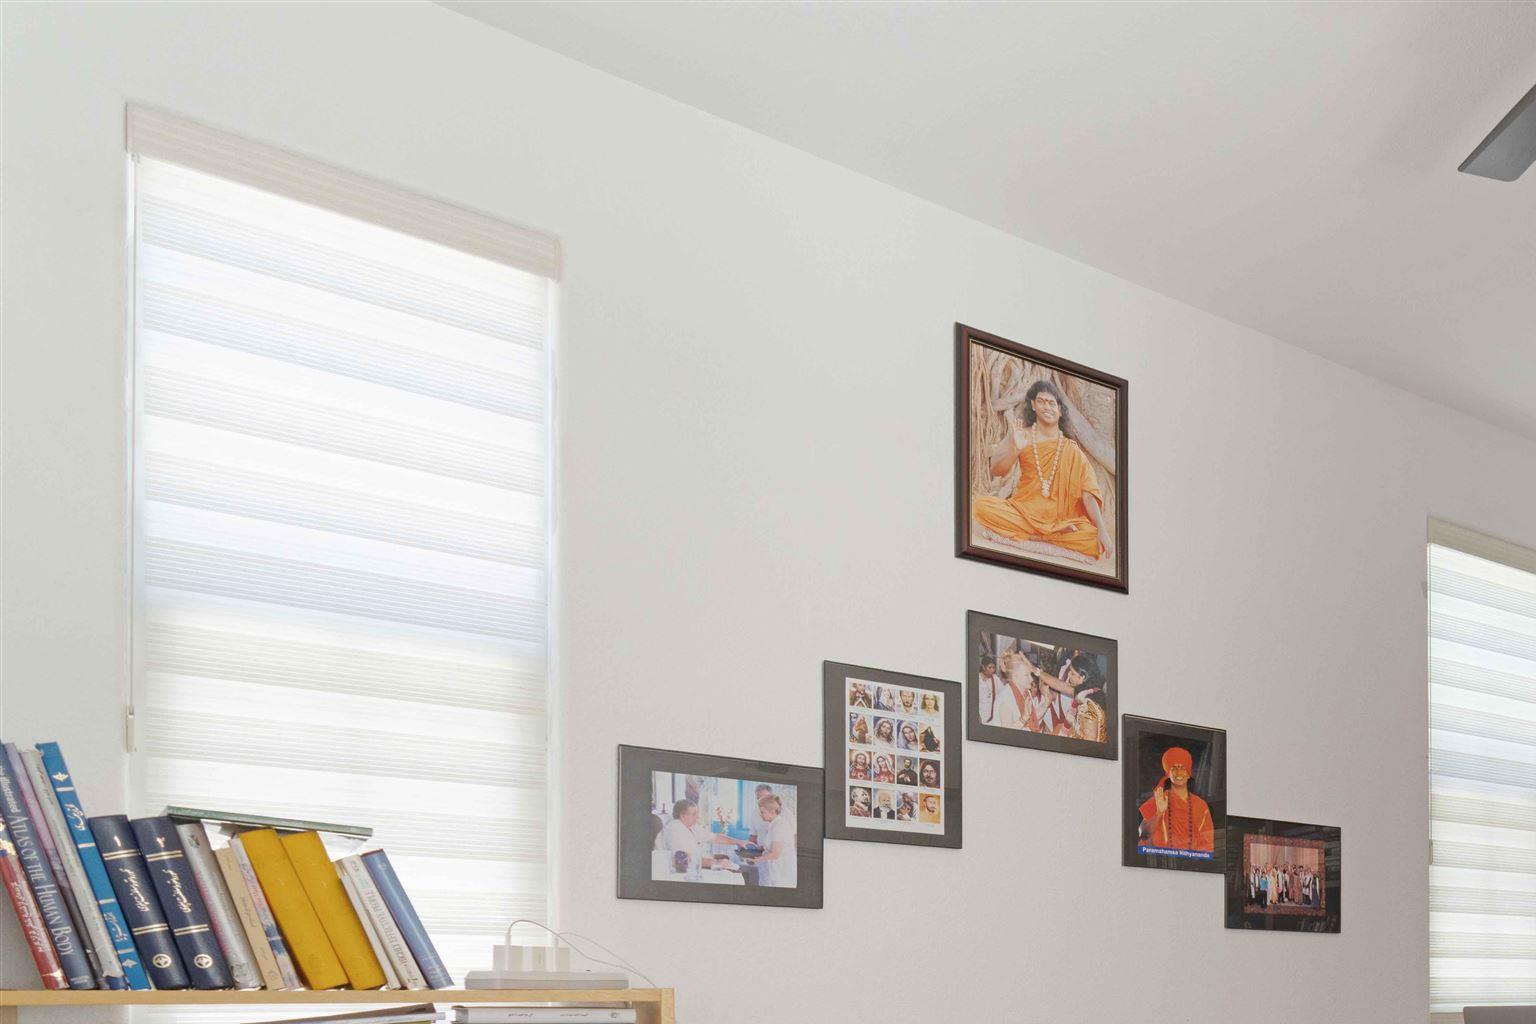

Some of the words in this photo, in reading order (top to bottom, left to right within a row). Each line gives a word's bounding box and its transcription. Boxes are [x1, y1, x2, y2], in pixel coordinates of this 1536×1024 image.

[7, 809, 35, 850] ATLAS
[19, 845, 40, 866] OF
[26, 860, 48, 884] THE
[33, 879, 64, 926] HUMAN
[50, 922, 77, 961] BODY
